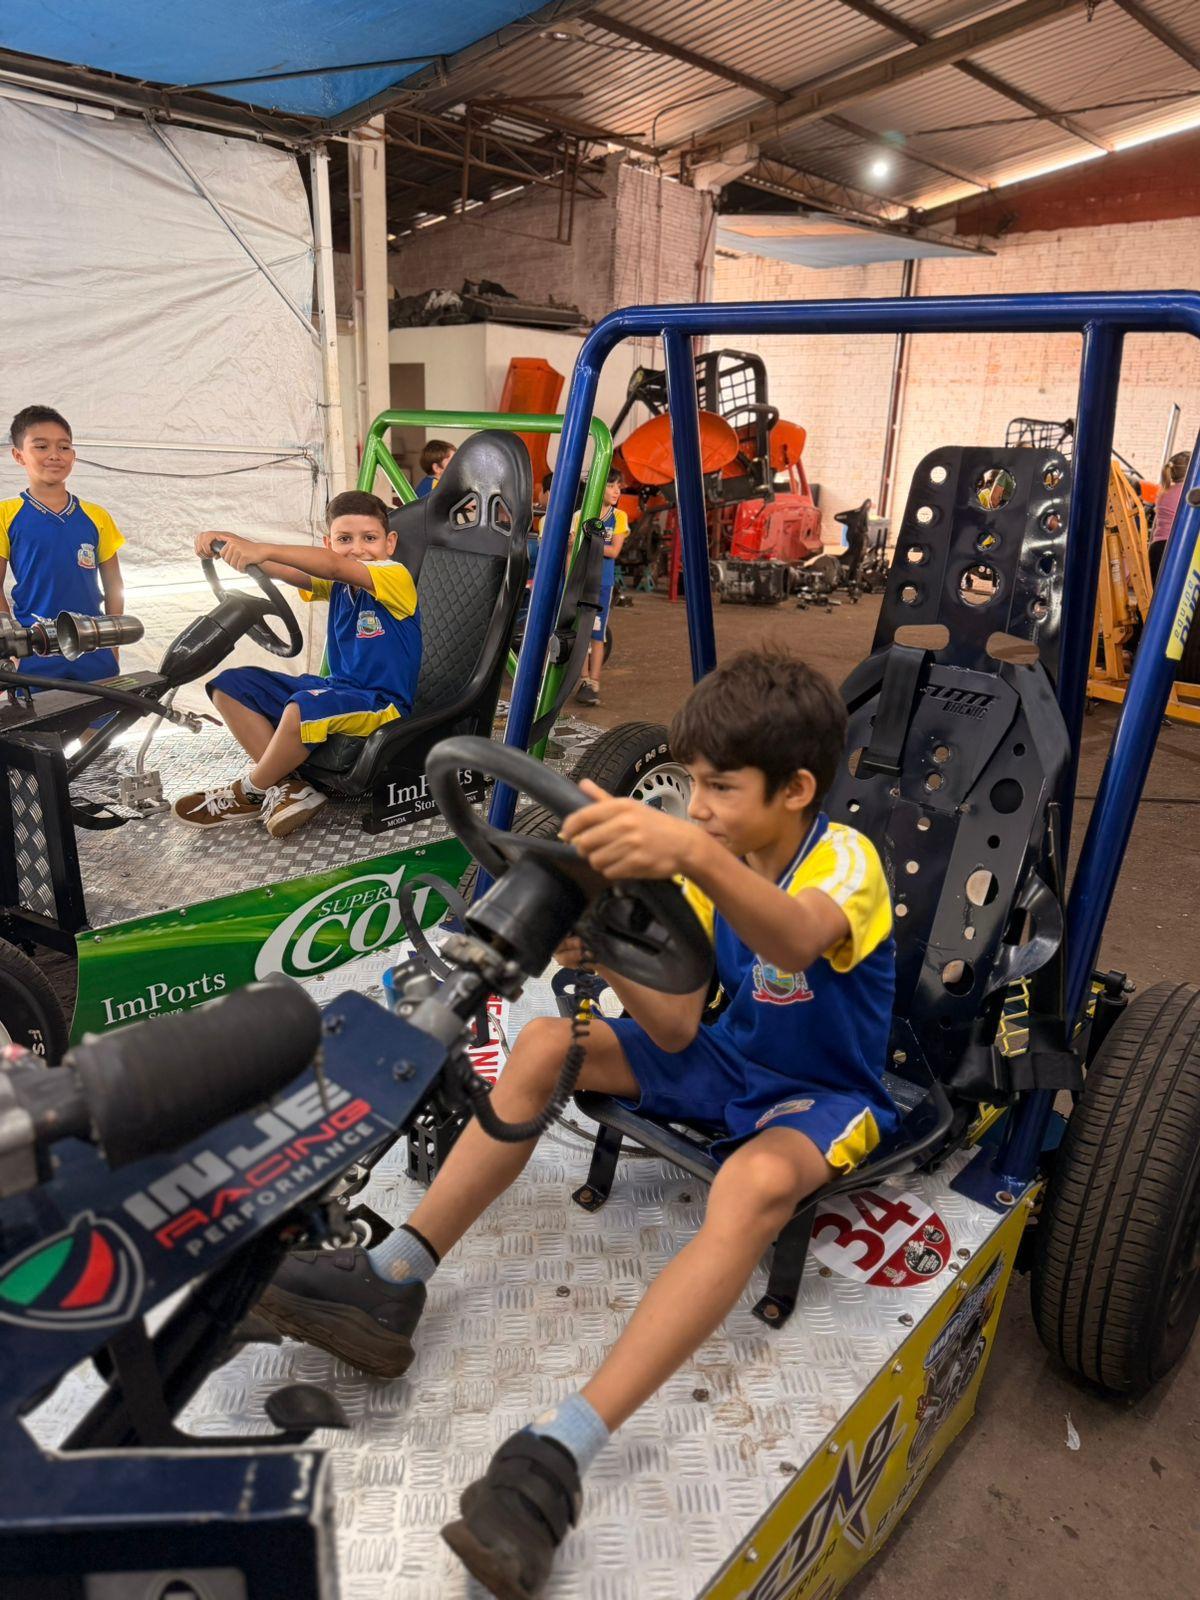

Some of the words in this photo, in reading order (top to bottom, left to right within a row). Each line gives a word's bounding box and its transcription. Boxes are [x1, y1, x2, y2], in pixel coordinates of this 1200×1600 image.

[414, 800, 436, 813] Stor
[317, 886, 390, 918] SUPER
[101, 972, 226, 1025] ImPorts
[122, 1077, 351, 1231] INJE
[154, 1098, 372, 1249] RACING
[185, 1121, 374, 1257] PERFORMANCE
[811, 1190, 920, 1272] 34
